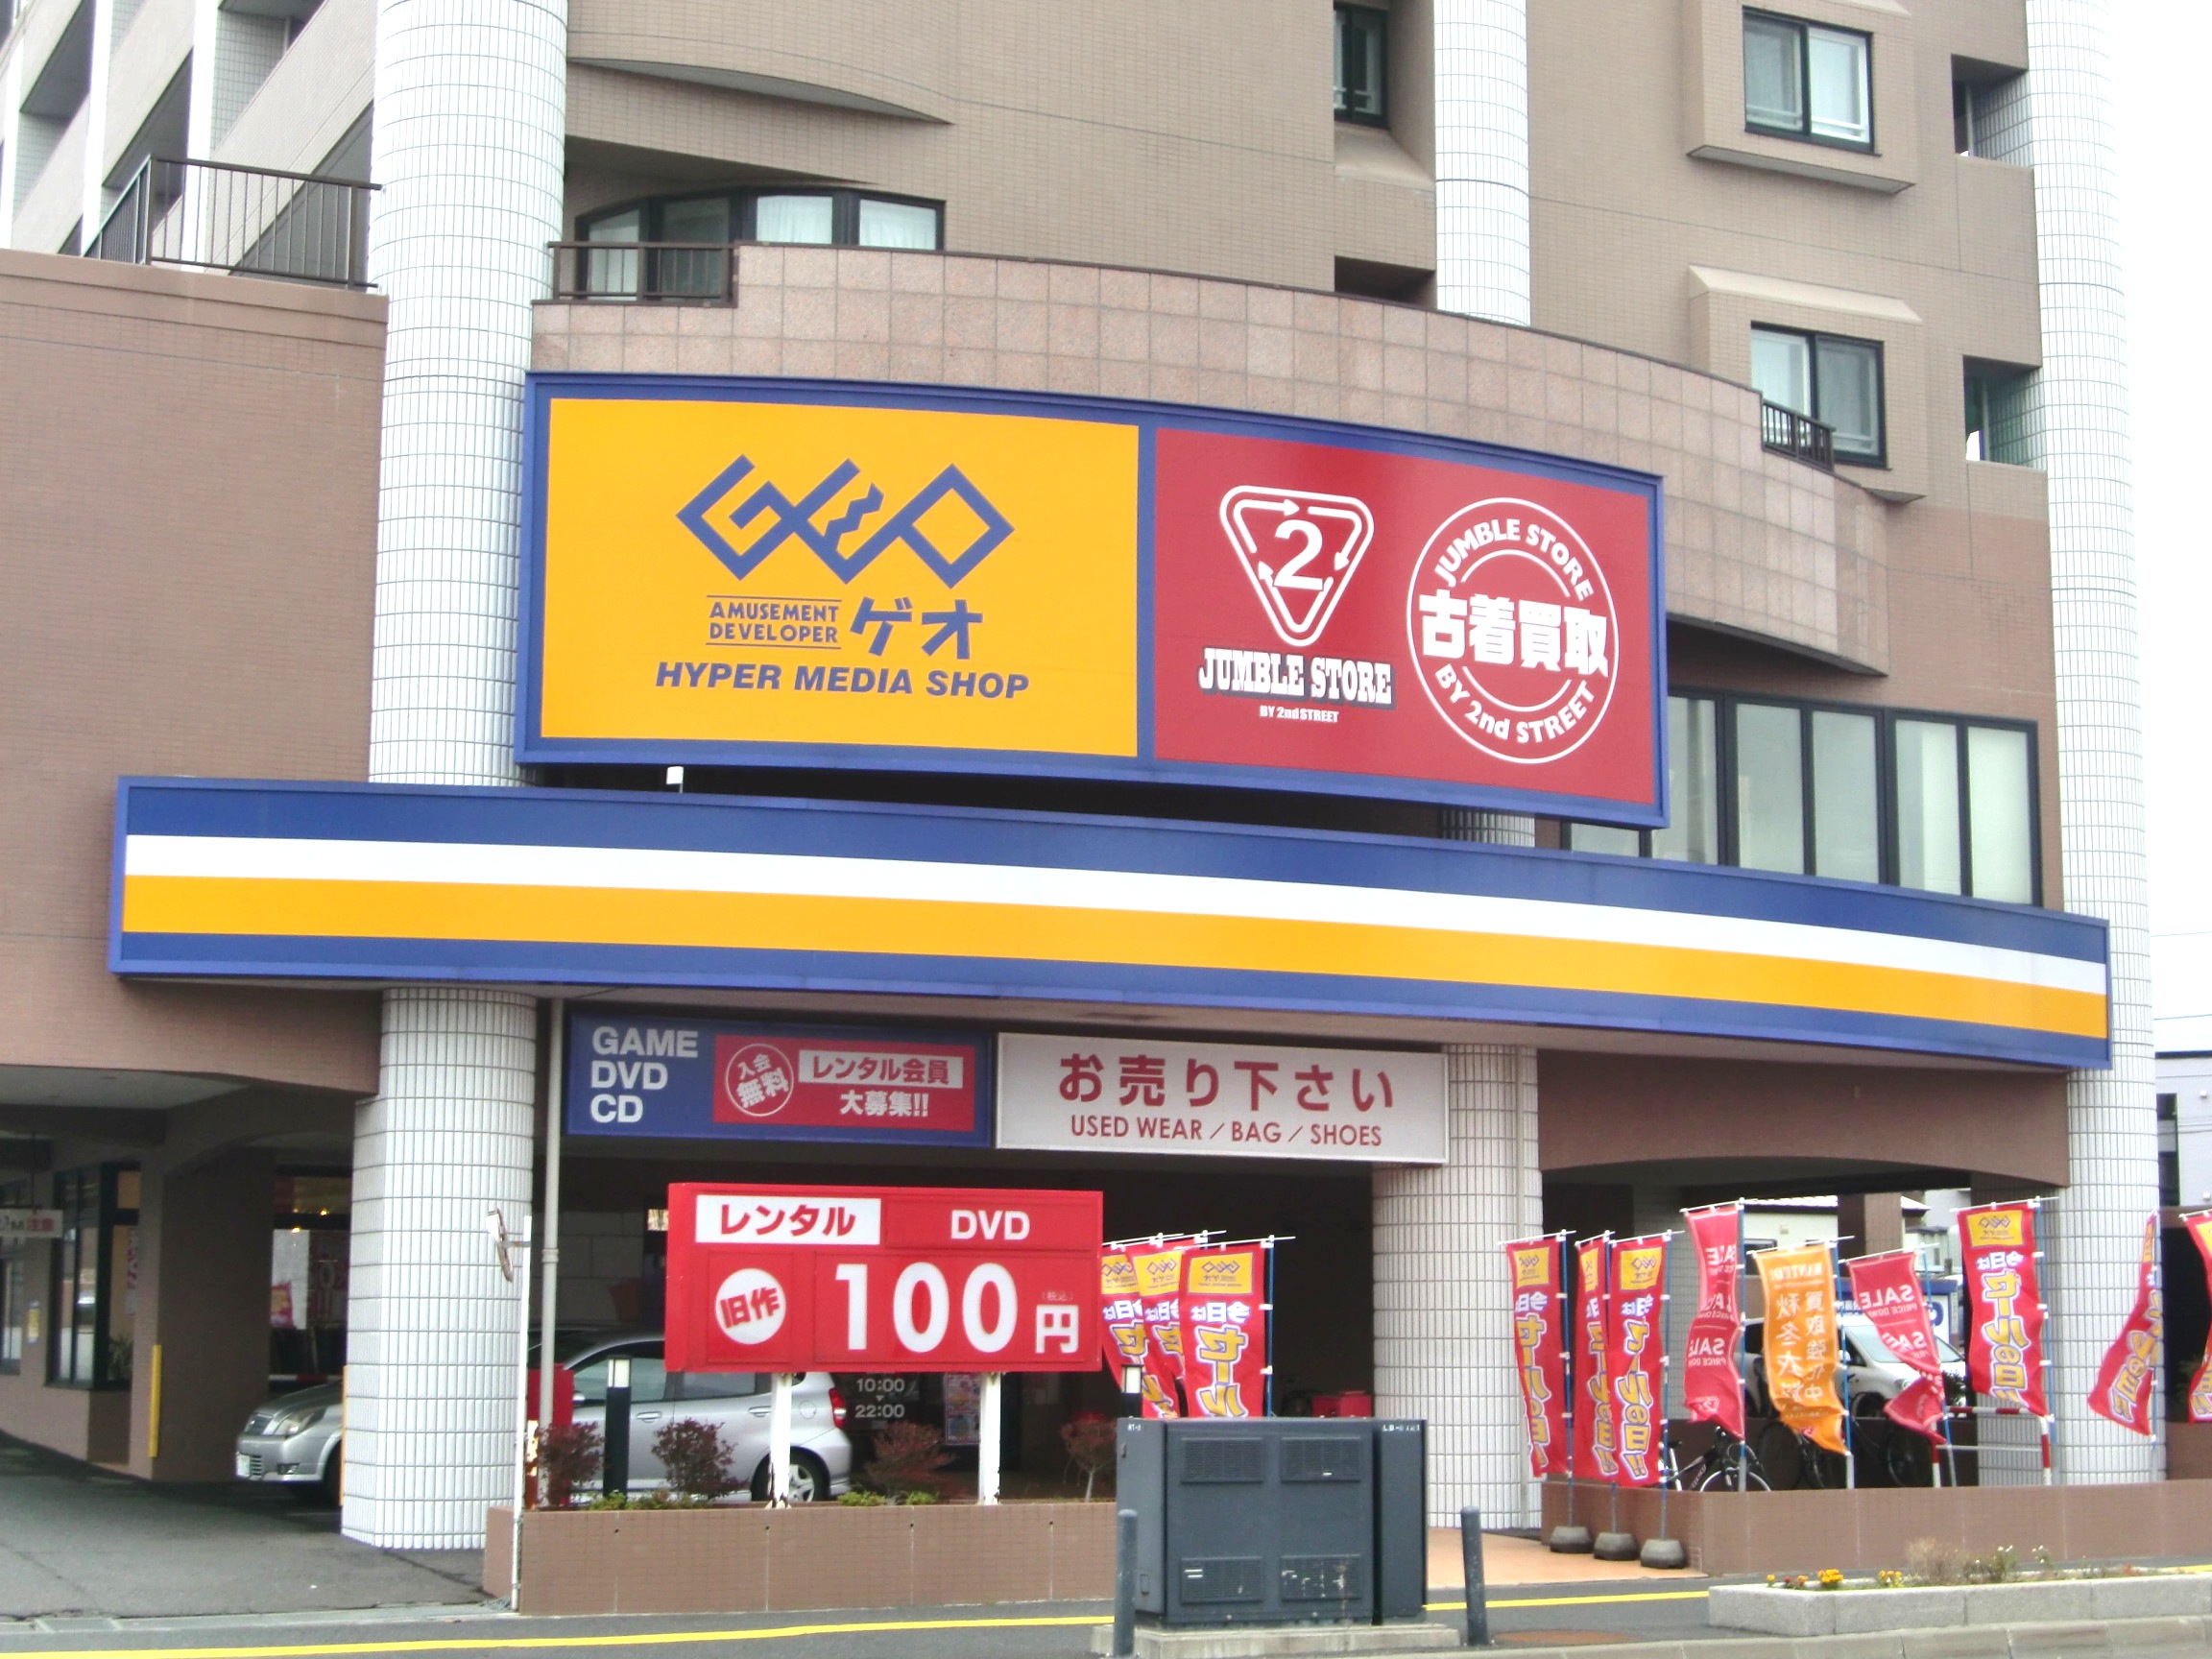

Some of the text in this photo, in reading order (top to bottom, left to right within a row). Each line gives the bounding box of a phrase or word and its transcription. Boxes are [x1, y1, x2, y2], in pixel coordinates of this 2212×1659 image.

[1273, 519, 1324, 591] 2
[1433, 518, 1594, 601] JUMBLE STORE
[709, 600, 839, 622] AMUSEMENT
[709, 621, 838, 643] DEVELOPER
[850, 595, 983, 661] ゲオ
[1419, 589, 1610, 678] 古着買取
[655, 661, 1029, 700] HYPER MEDIA SHOP
[1198, 647, 1392, 705] JUMBLE STORE
[1260, 705, 1275, 717] BY
[1434, 664, 1595, 744] BY 2nd STREET
[592, 1026, 698, 1058] GAME
[590, 1060, 668, 1091] DVD
[736, 1052, 773, 1081] 入会
[812, 1055, 950, 1085] レンタル会員
[1059, 1053, 1393, 1112] お売り下さい
[735, 1071, 790, 1110] 無料
[589, 1094, 643, 1123] CD
[1071, 1115, 1129, 1138] USED
[1232, 1120, 1282, 1143] BAG
[1310, 1123, 1382, 1146] SHOES
[720, 1203, 856, 1238] レンタル
[950, 1210, 1030, 1240] DVD
[720, 1286, 781, 1329] 旧作
[856, 1379, 905, 1392] 10:00
[854, 1405, 905, 1418] 22:00
